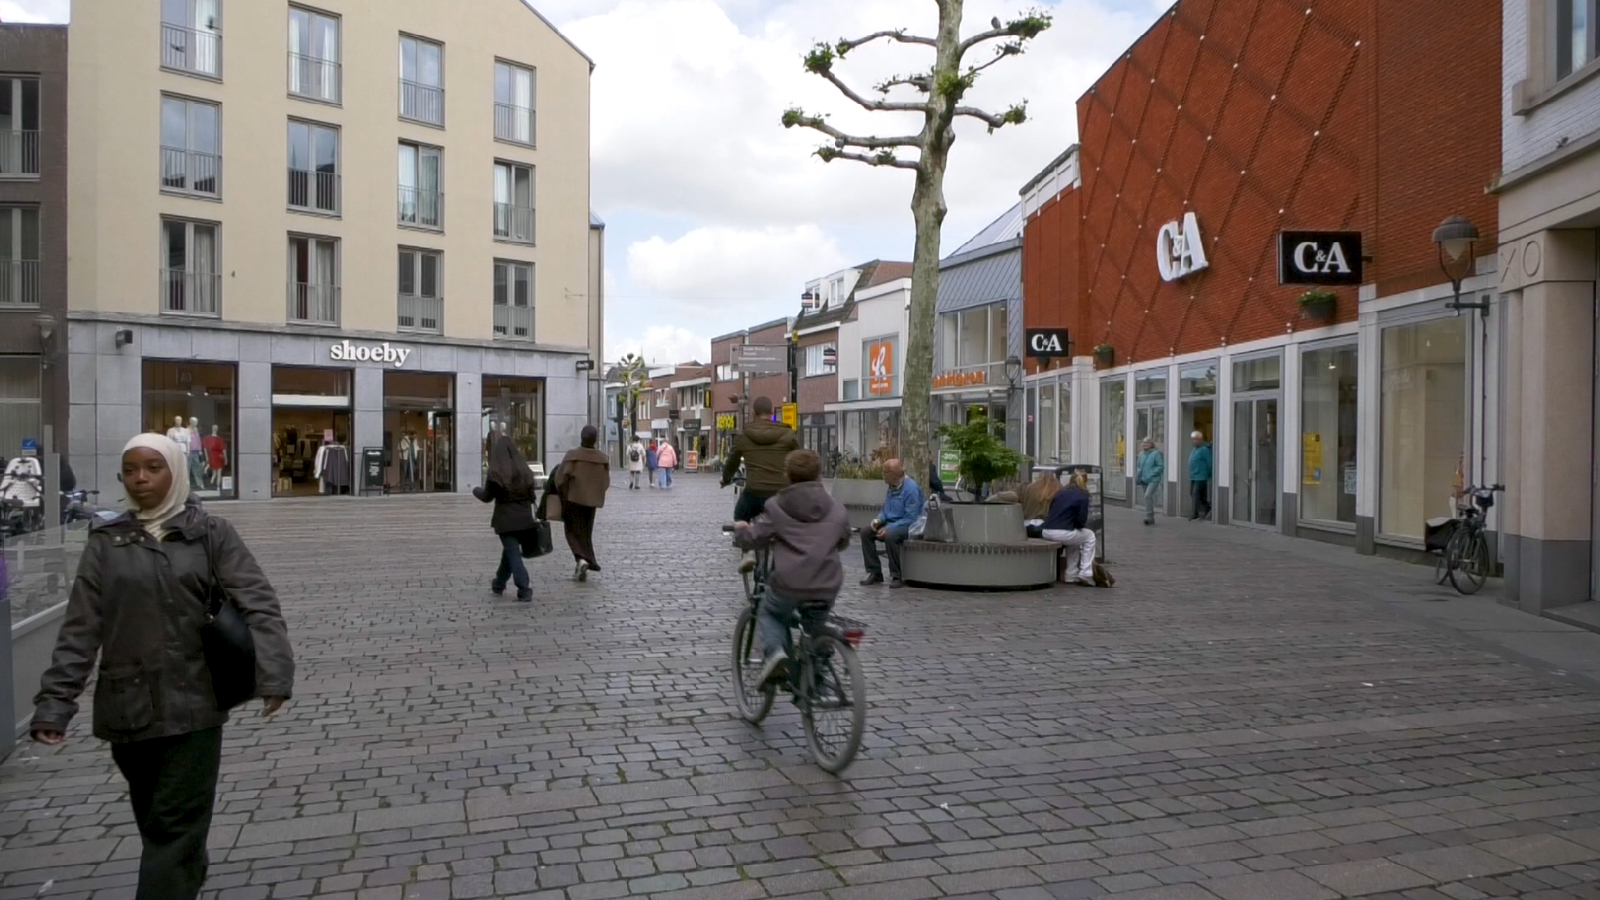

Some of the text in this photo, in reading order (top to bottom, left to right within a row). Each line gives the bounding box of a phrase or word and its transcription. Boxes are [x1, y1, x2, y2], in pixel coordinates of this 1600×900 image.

[1157, 212, 1208, 281] C&A
[1294, 242, 1351, 273] C&A
[330, 340, 411, 367] shoeby
[1031, 333, 1062, 352] C&A
